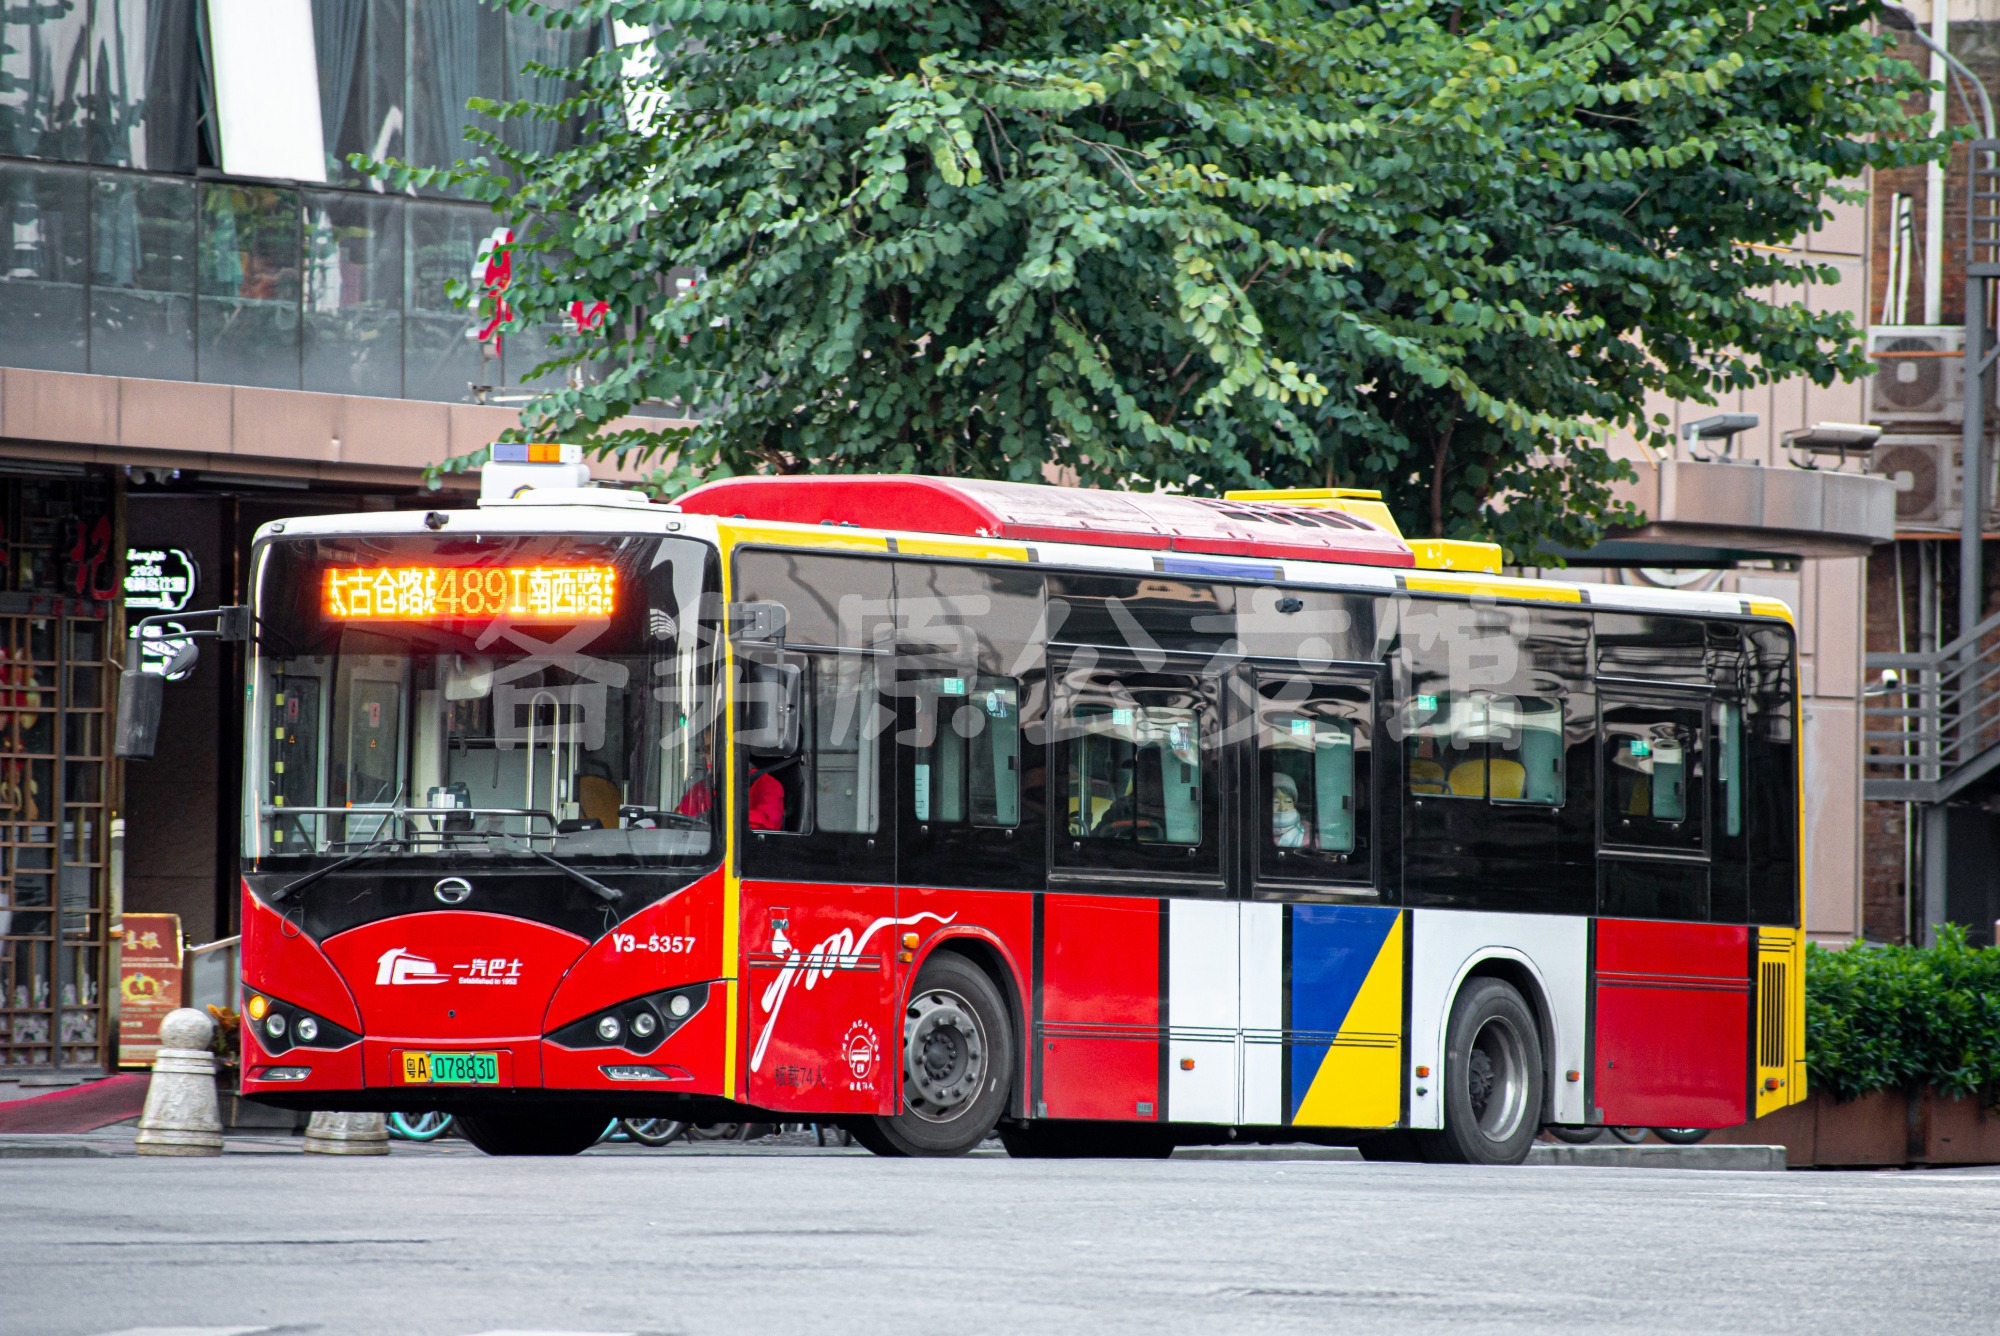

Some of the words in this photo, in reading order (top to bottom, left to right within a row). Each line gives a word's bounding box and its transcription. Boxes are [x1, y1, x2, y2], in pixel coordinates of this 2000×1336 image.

[437, 569, 508, 614] 489
[612, 934, 696, 954] Y3-5357
[452, 958, 524, 977] 一汽巴士
[406, 1057, 427, 1079] 粤A
[435, 1057, 496, 1079] 07883D
[775, 1065, 826, 1089] 核载74人
